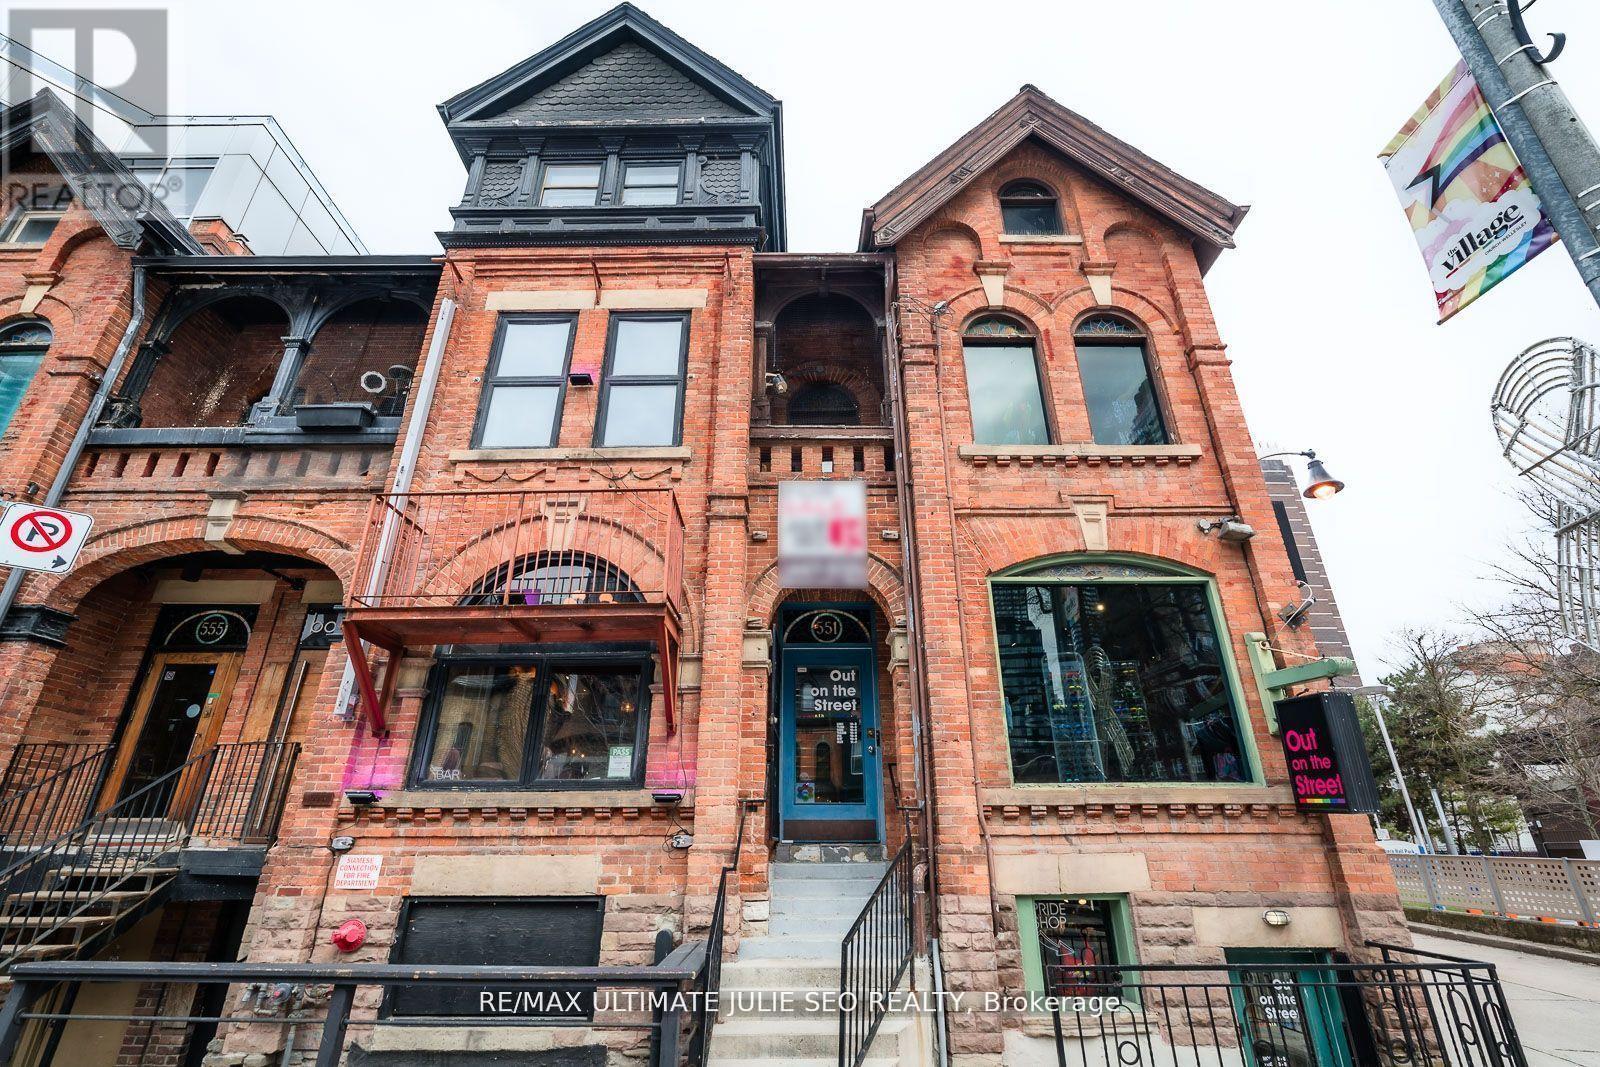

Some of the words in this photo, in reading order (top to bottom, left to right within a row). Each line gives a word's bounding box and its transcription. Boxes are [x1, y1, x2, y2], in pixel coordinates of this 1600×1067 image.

[1442, 204, 1520, 271] village
[1447, 246, 1458, 257] the
[200, 622, 225, 635] 555
[815, 621, 837, 634] 551
[830, 669, 856, 682] Out
[810, 686, 829, 697] on
[832, 684, 857, 697] the
[814, 699, 858, 711] Street
[1285, 727, 1318, 752] Out
[612, 748, 631, 756] PASS
[1292, 758, 1309, 771] on
[1309, 755, 1332, 770] the
[436, 769, 460, 780] BAR
[1295, 773, 1344, 796] Street
[335, 879, 377, 887] DEPARTMENT
[1259, 995, 1275, 1005] on
[1277, 992, 1297, 1005] the
